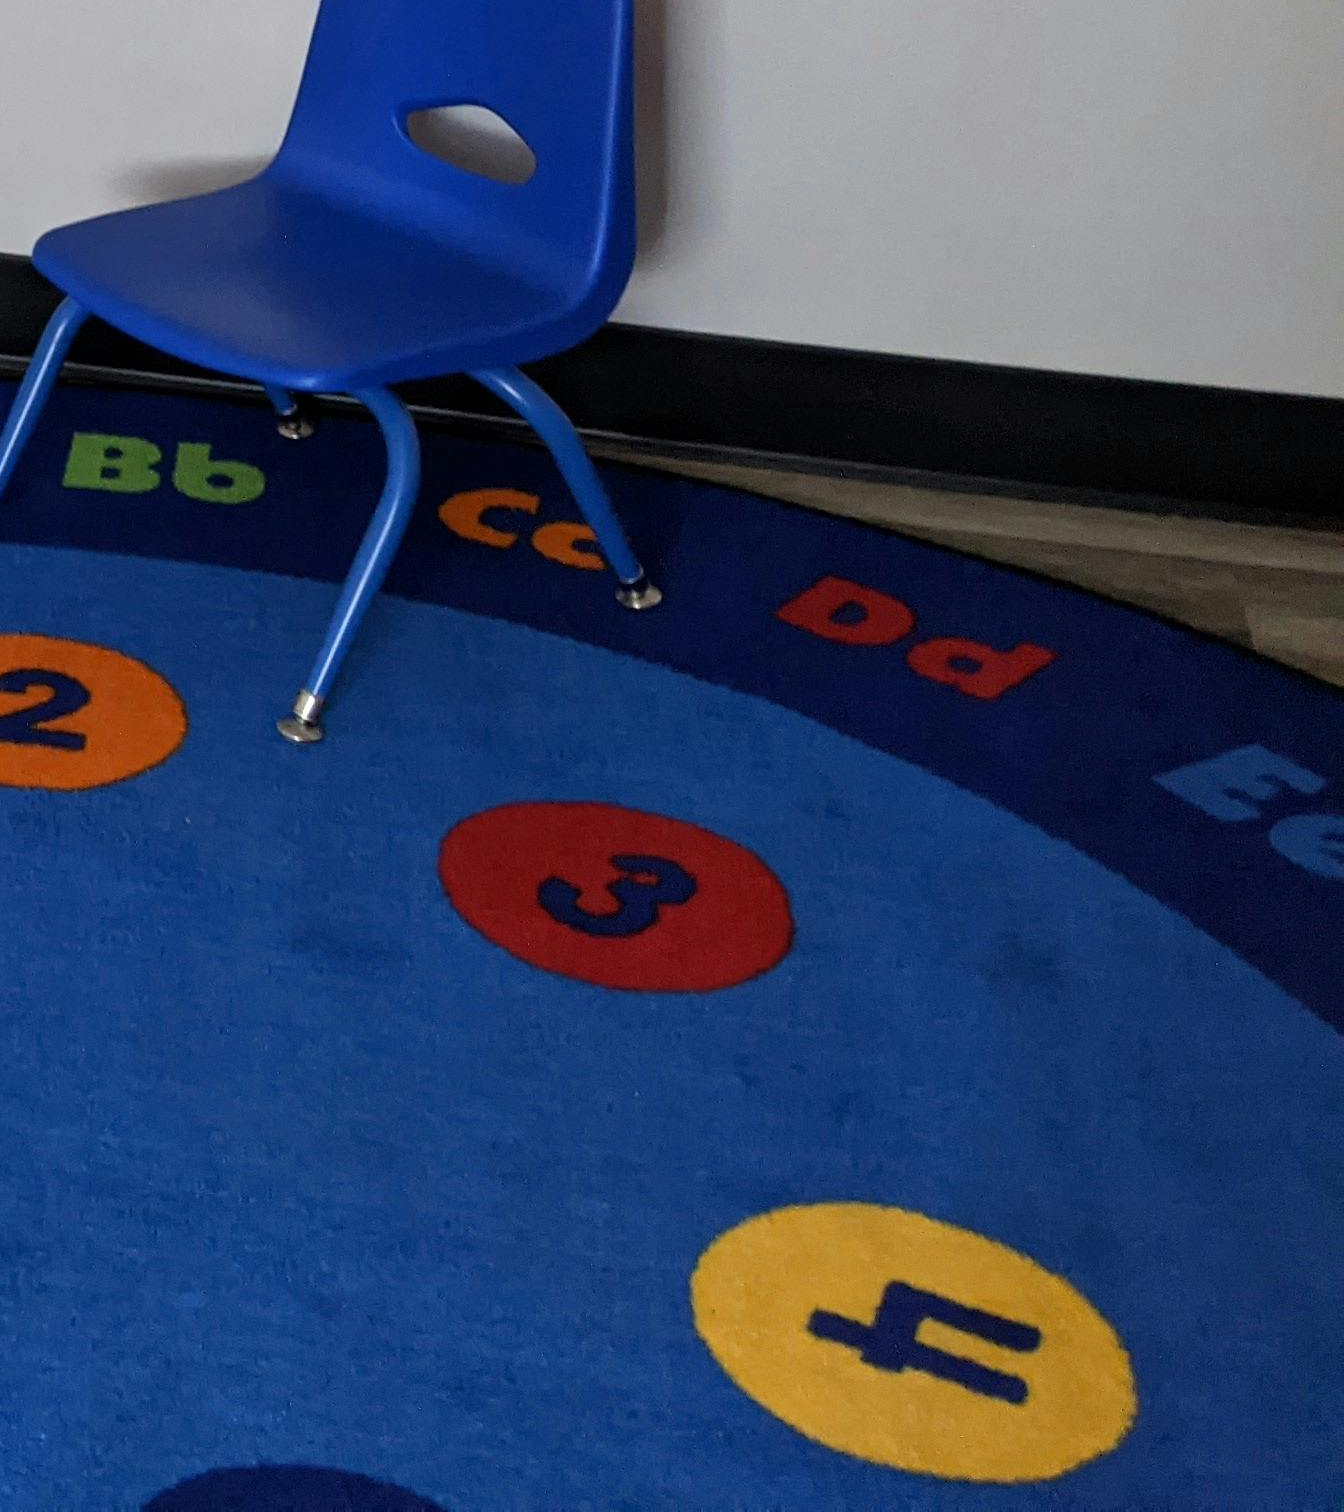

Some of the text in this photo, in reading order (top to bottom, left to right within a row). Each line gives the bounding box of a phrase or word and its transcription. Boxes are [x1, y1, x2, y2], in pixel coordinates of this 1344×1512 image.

[62, 431, 265, 503] Bb
[774, 576, 1057, 699] Dd
[536, 854, 698, 938] 3
[807, 1278, 1042, 1404] 4
